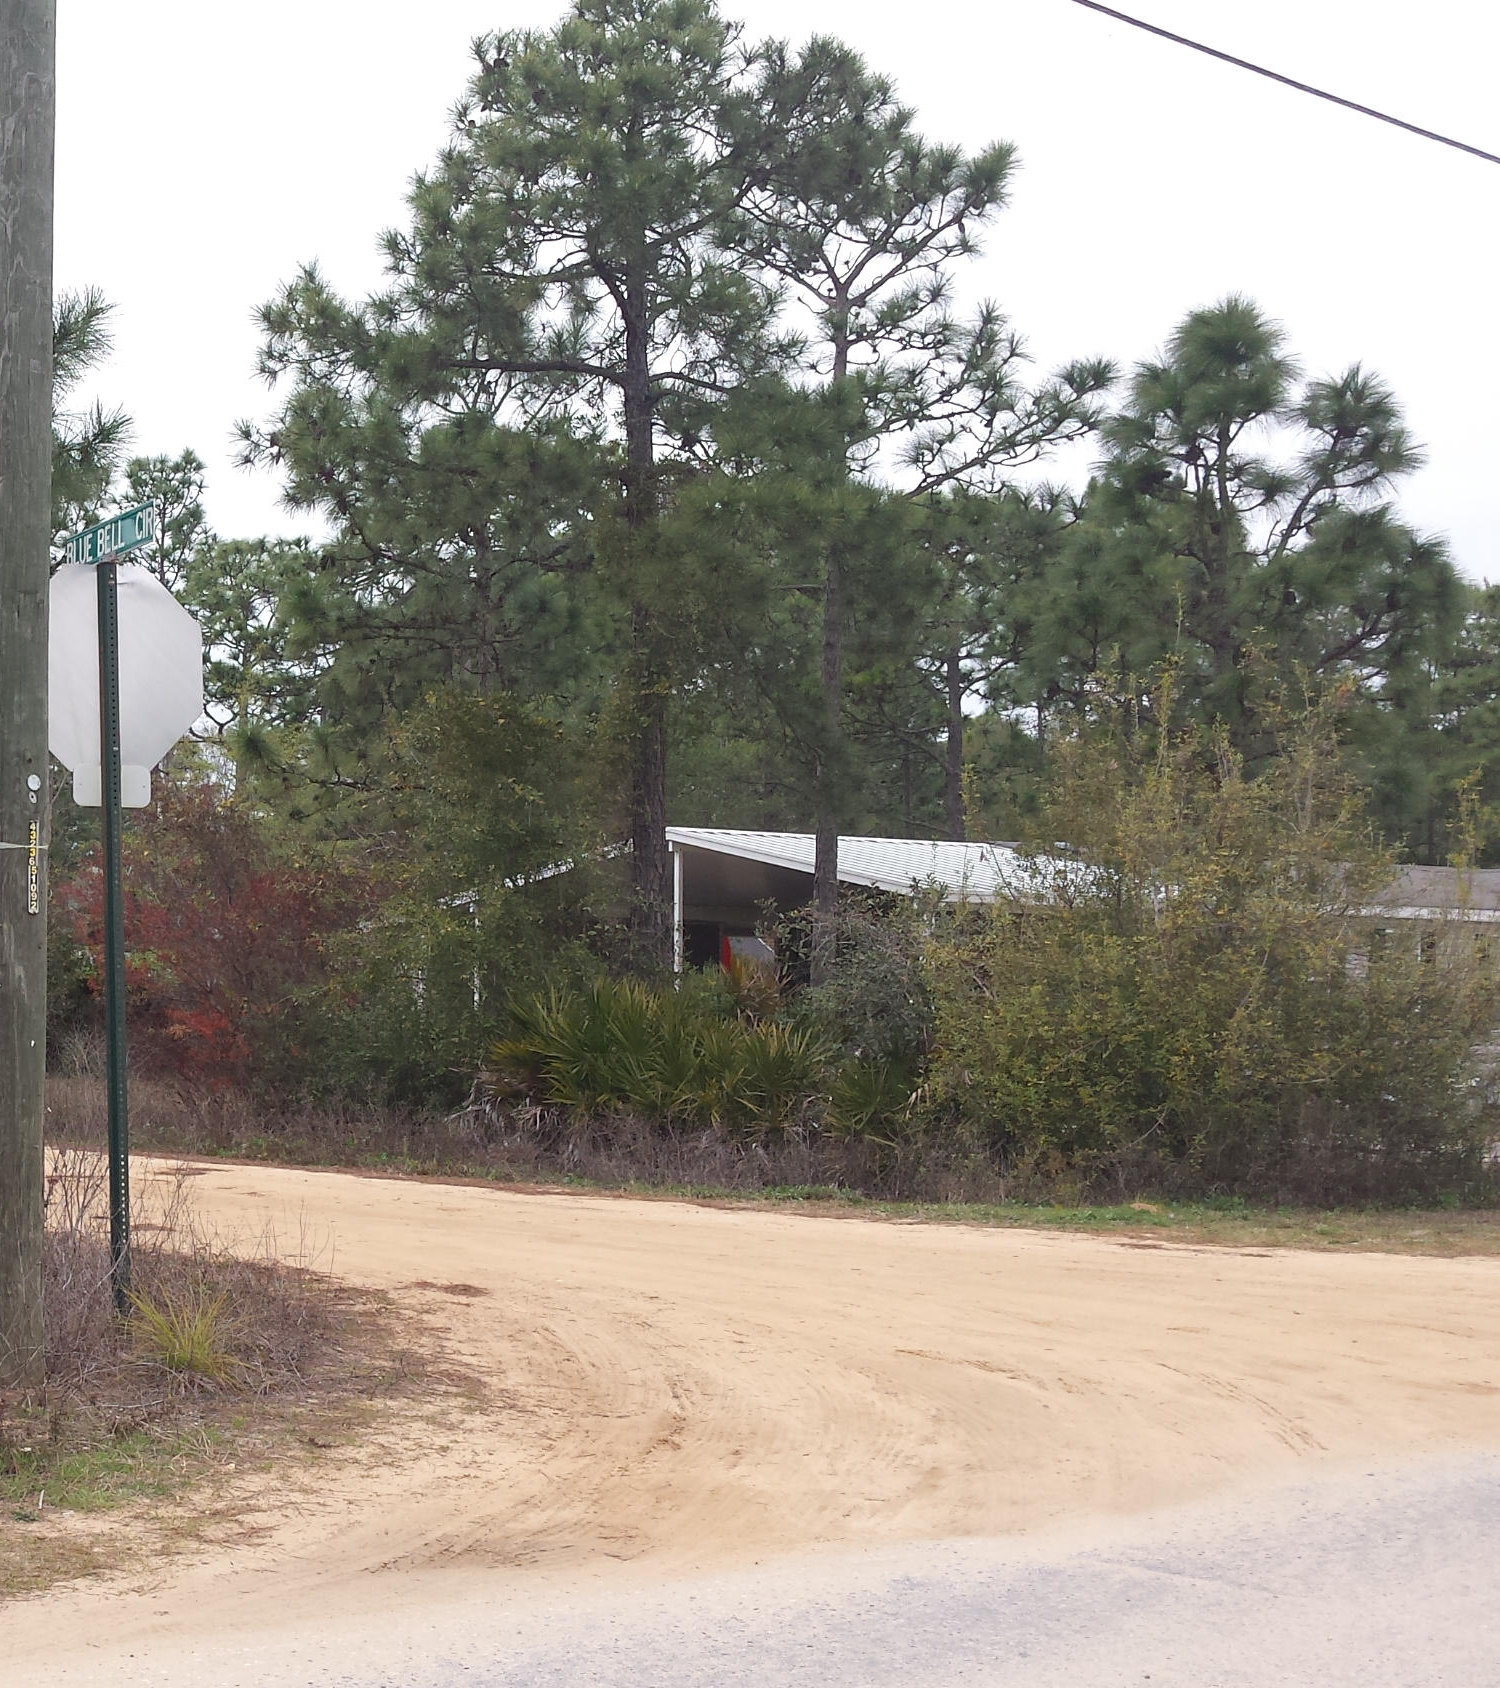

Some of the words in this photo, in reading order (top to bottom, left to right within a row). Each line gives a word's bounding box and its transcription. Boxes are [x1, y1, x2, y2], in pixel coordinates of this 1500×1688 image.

[66, 533, 93, 565] BLUE
[97, 521, 125, 557] BELL
[135, 506, 153, 540] CIR
